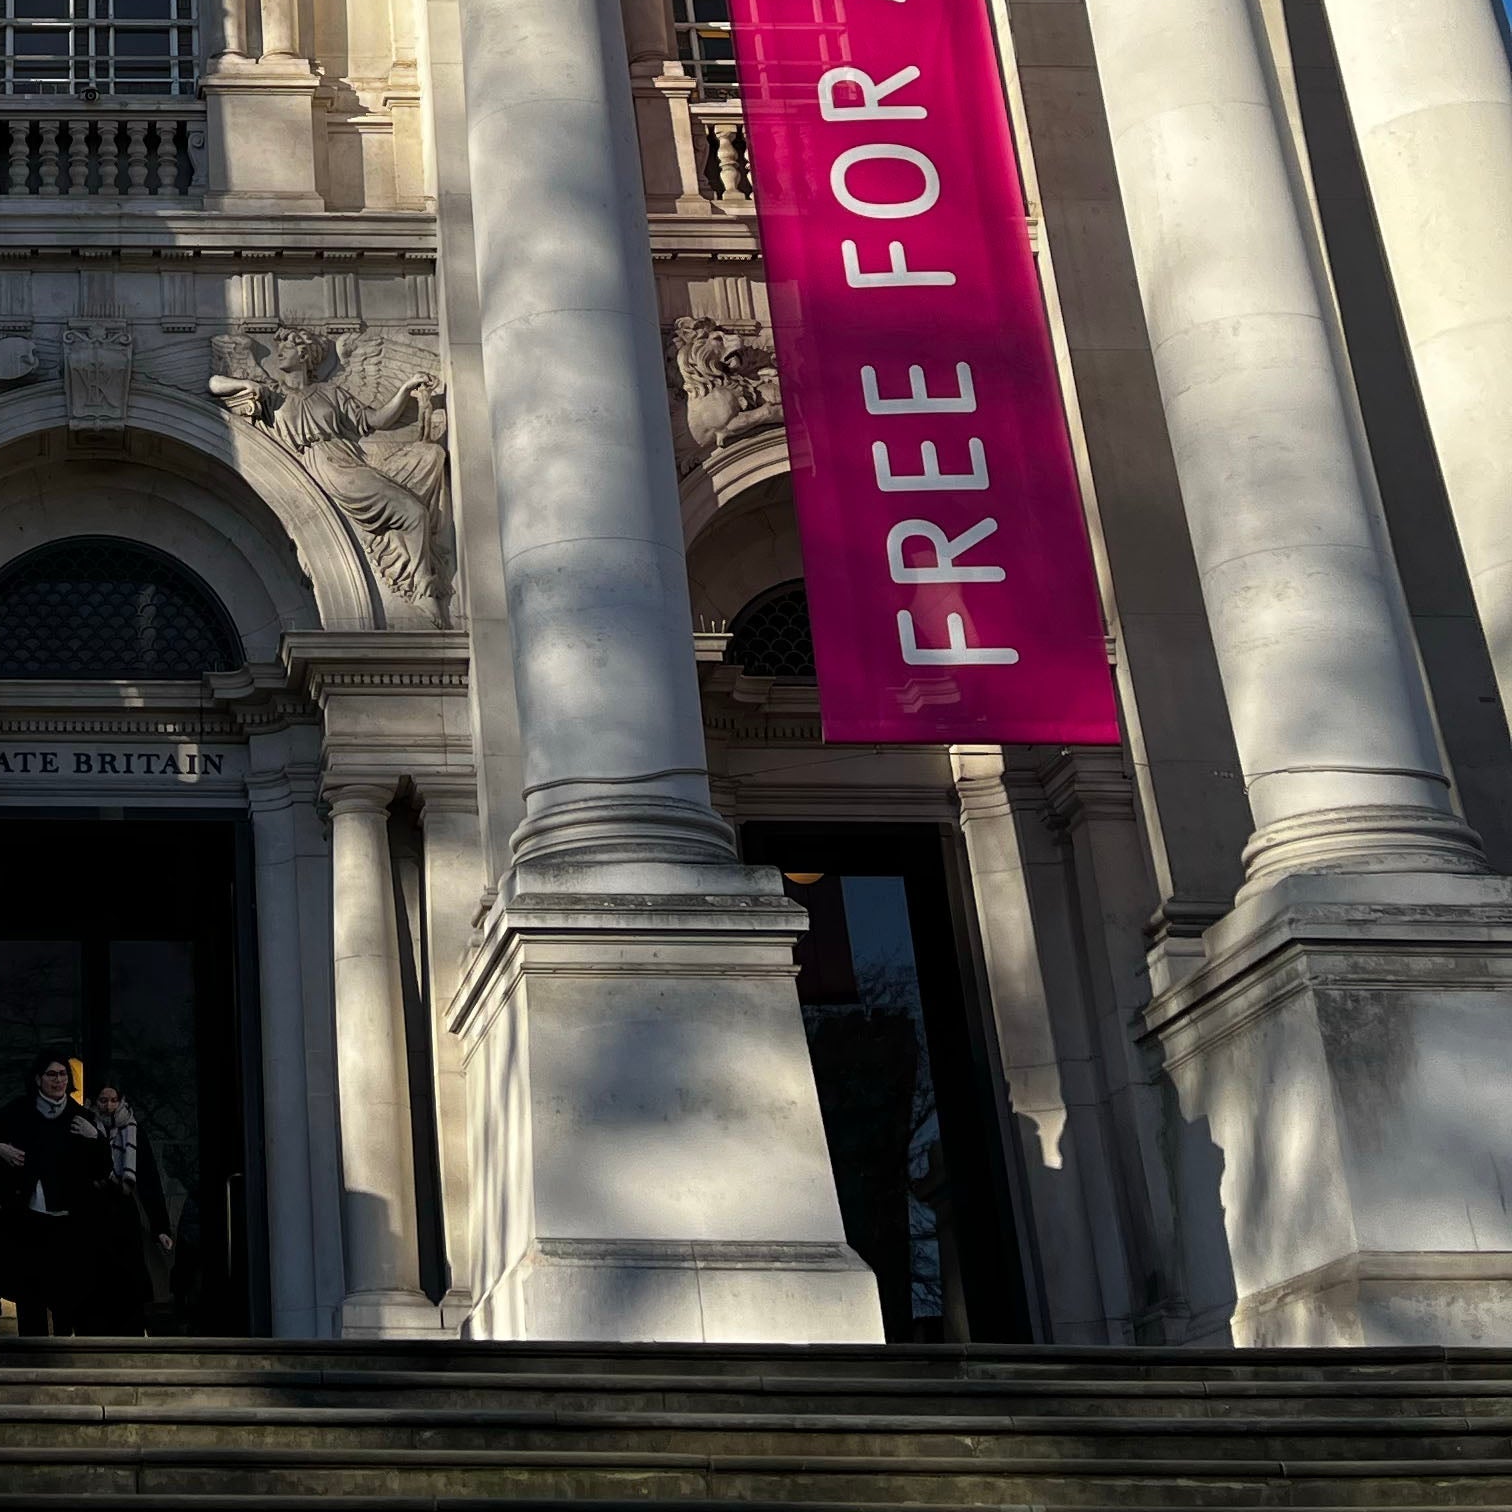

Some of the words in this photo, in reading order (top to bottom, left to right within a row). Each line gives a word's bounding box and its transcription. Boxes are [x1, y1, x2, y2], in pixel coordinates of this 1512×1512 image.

[818, 65, 956, 288] FOR
[861, 361, 1019, 665] FREE
[73, 753, 224, 775] BRITAIN
